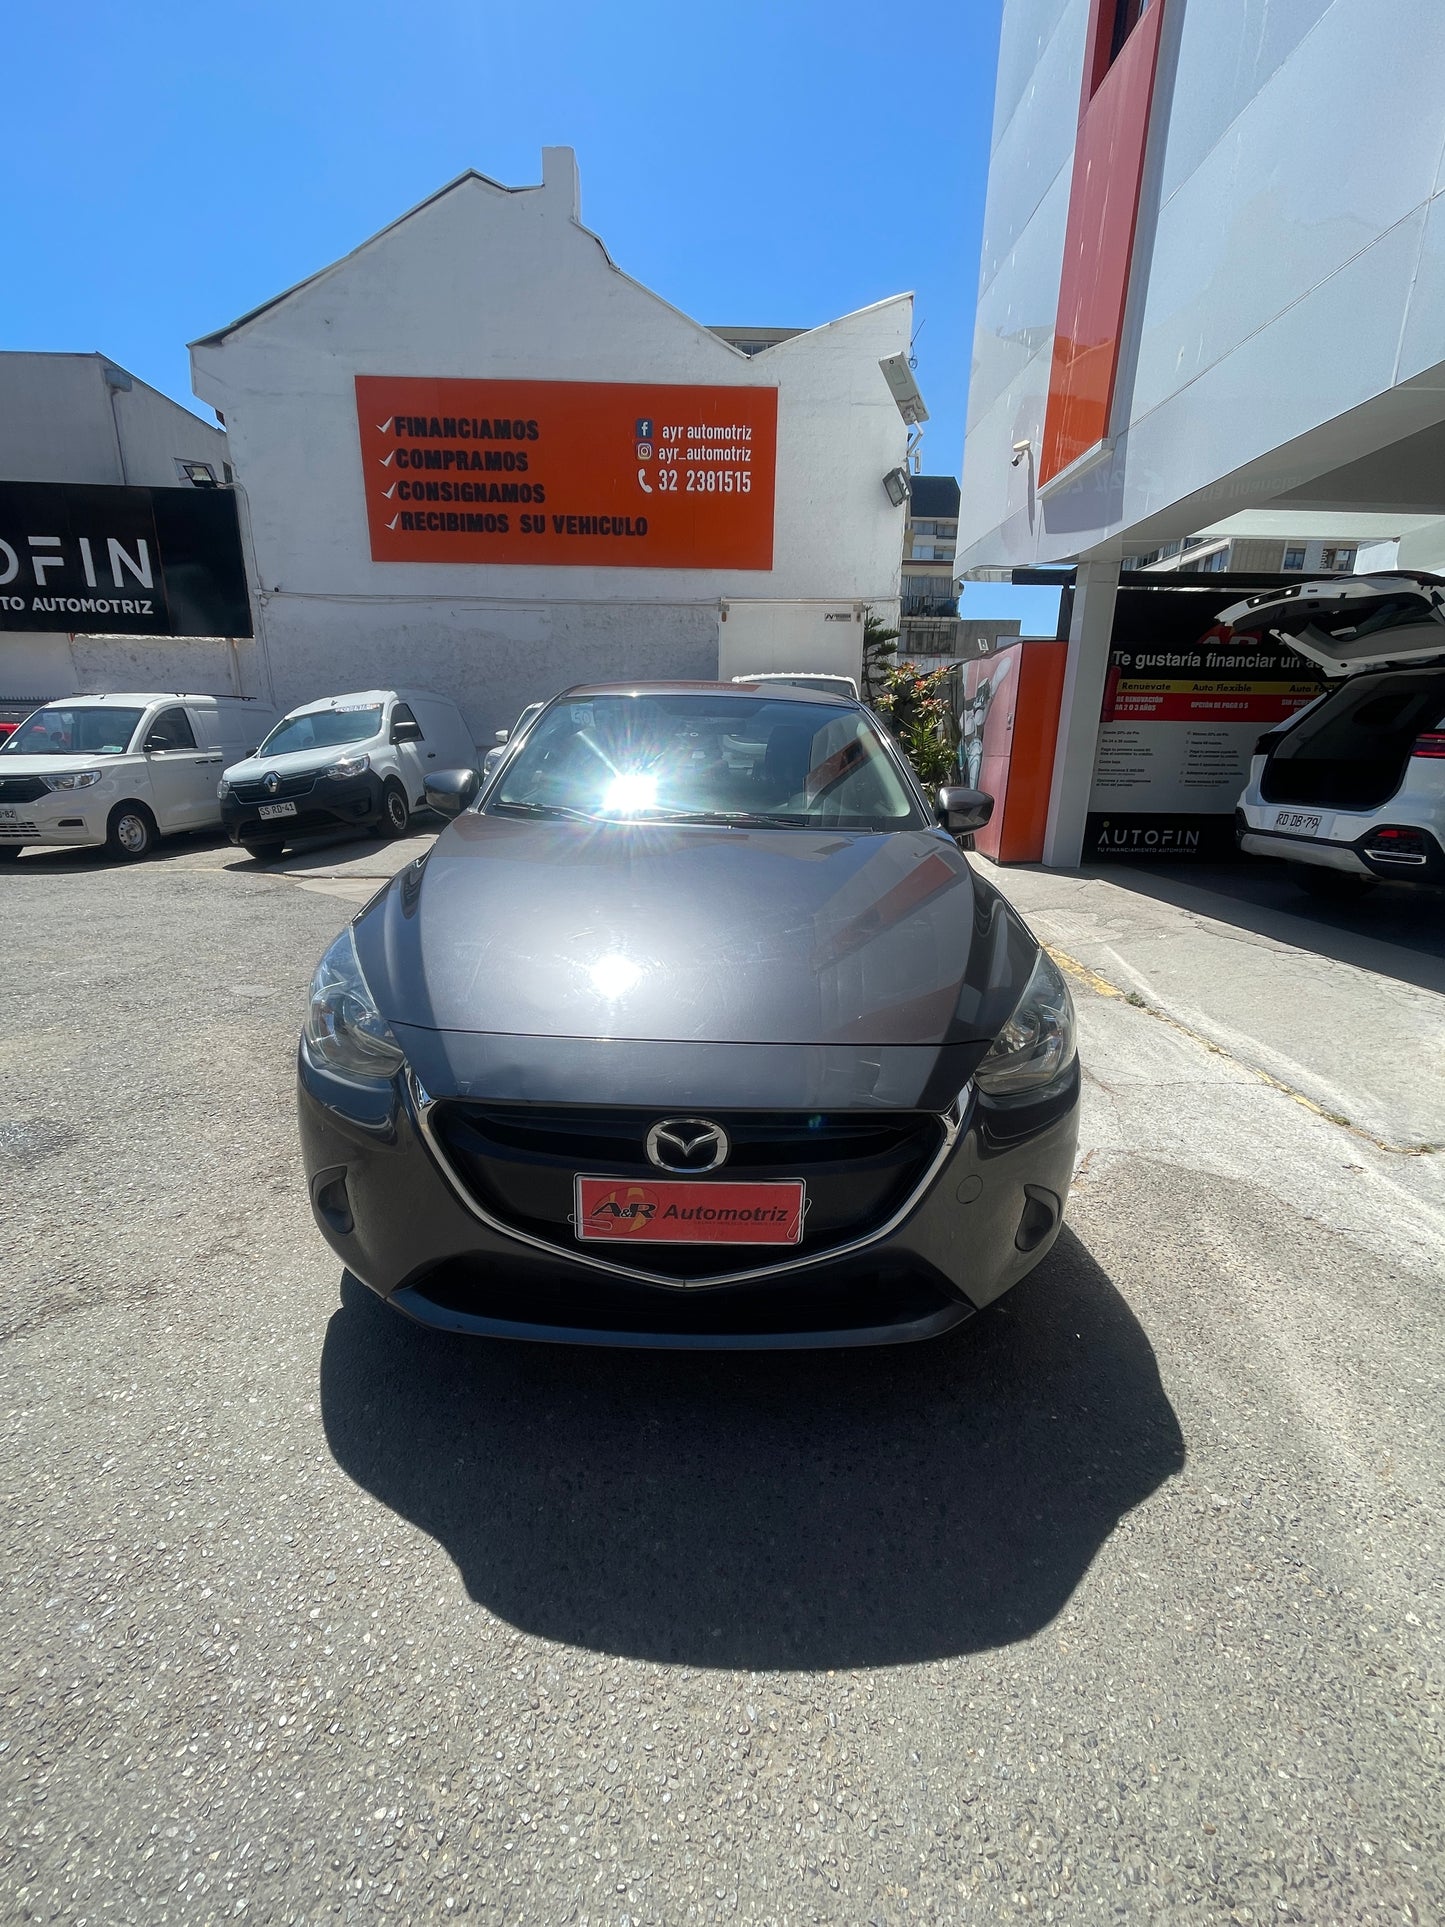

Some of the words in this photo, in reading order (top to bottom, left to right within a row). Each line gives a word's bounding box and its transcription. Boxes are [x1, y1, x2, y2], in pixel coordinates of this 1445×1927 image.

[394, 416, 539, 440] FINANCIAMOS
[662, 424, 685, 442] ayr
[687, 423, 752, 441] automotriz
[396, 448, 529, 472] COMPRAMOS
[658, 444, 752, 464] ayr_automotriz
[658, 470, 678, 492] 32
[686, 469, 752, 493] 2381515
[398, 480, 546, 503] CONSIGNAMOS
[401, 511, 509, 534] RECIBIMOS
[520, 513, 546, 534] SU
[552, 514, 648, 537] VEHICULO
[32, 597, 154, 615] AUTOMOTRIZ
[1113, 650, 1131, 666] Te
[1135, 651, 1201, 670] gustaría
[1205, 652, 1277, 668] financiar
[1280, 656, 1301, 668] un
[1121, 682, 1171, 691] Renuevate
[1192, 683, 1213, 692] Auto
[1216, 683, 1252, 692] Flexible
[1289, 684, 1312, 692] Auto
[1098, 827, 1200, 846] AUTOFIN
[592, 1201, 657, 1219] A&R
[662, 1203, 789, 1223] Automotriz
